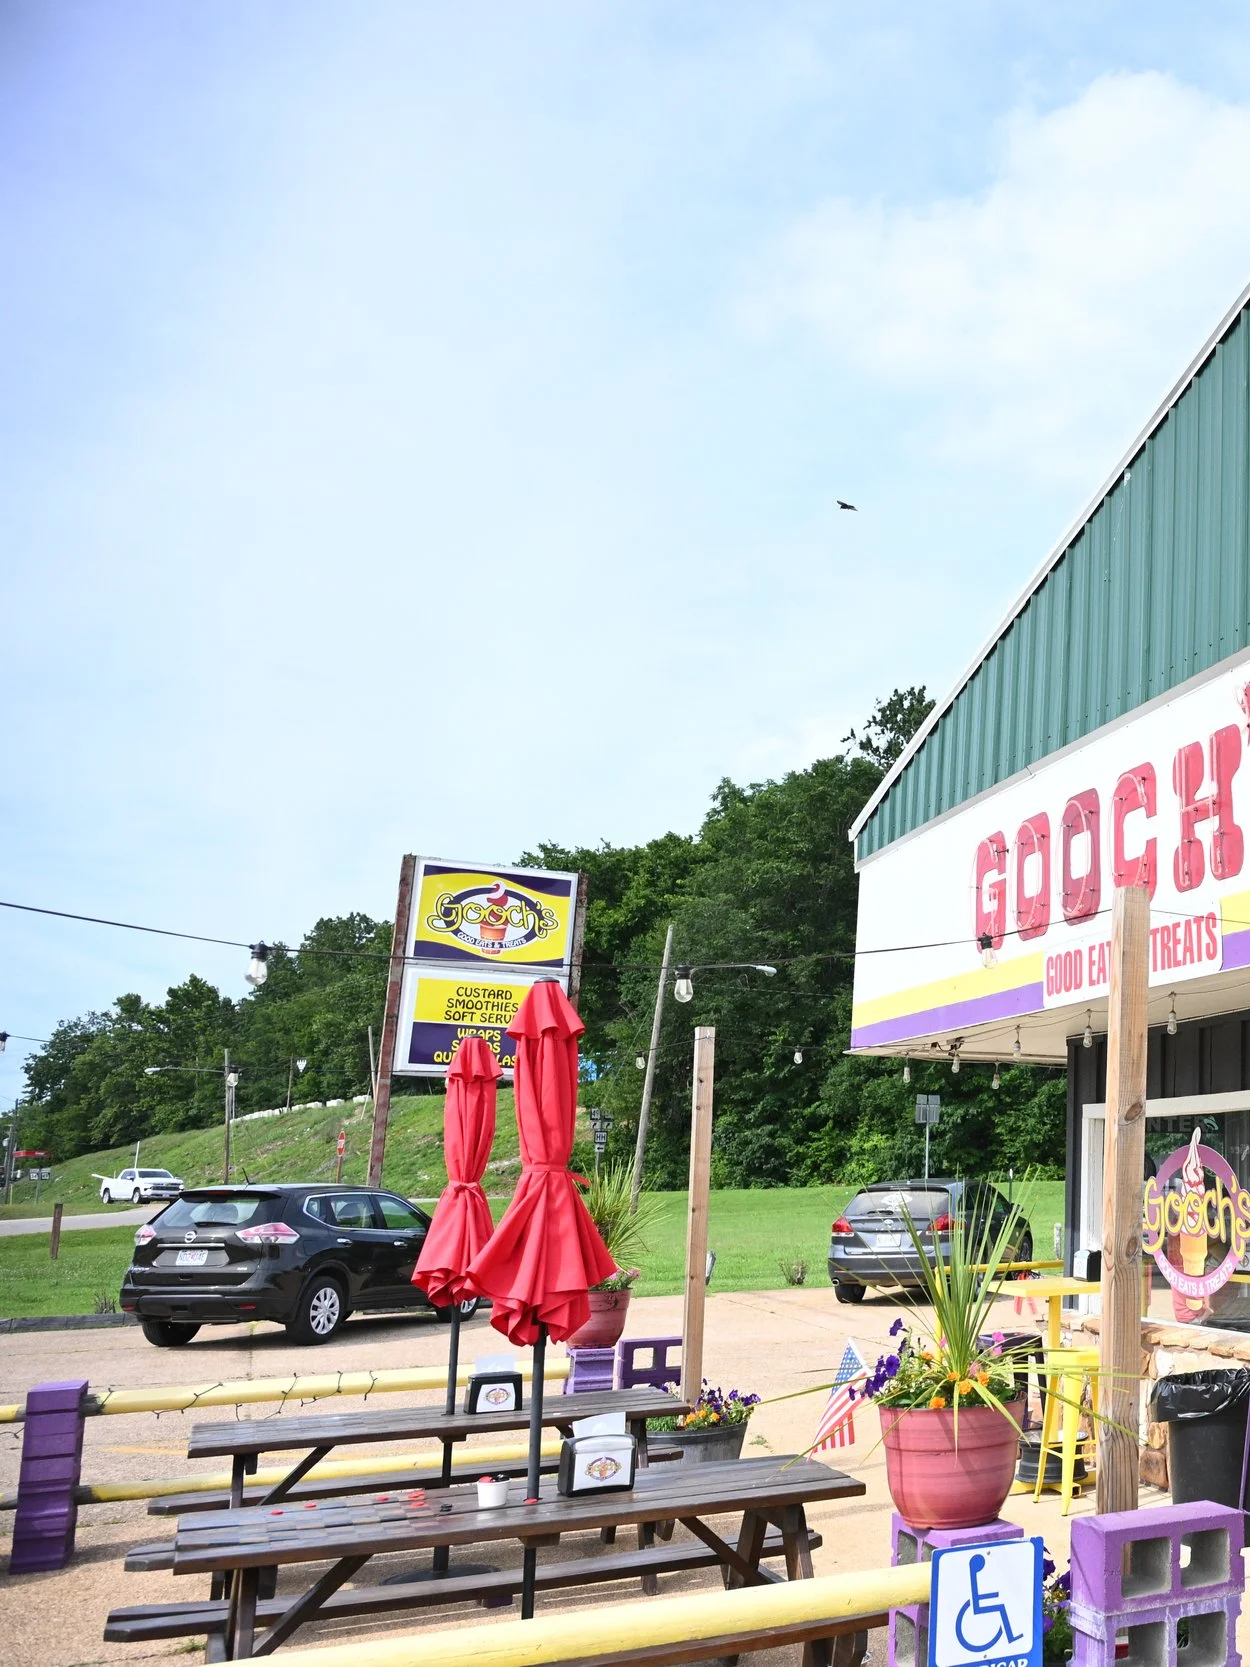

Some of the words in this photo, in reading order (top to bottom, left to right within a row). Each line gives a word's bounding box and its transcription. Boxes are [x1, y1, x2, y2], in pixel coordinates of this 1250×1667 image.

[426, 892, 559, 939] Gooch's
[457, 931, 475, 944] GOOD
[475, 940, 493, 948] EATS
[502, 937, 527, 948] TREATS
[1046, 949, 1083, 997] GOOD
[1088, 940, 1112, 987] EAT
[1150, 911, 1218, 972] TREATS
[456, 986, 513, 1000] CUSTARD
[446, 998, 519, 1013] SMOOTHIES
[444, 1010, 476, 1022] SOFT
[479, 1013, 516, 1024] SERV
[1158, 1254, 1178, 1286] GOOD
[1178, 1276, 1197, 1295] EATS
[1198, 1284, 1204, 1295] &
[1205, 1259, 1234, 1291] TREATS
